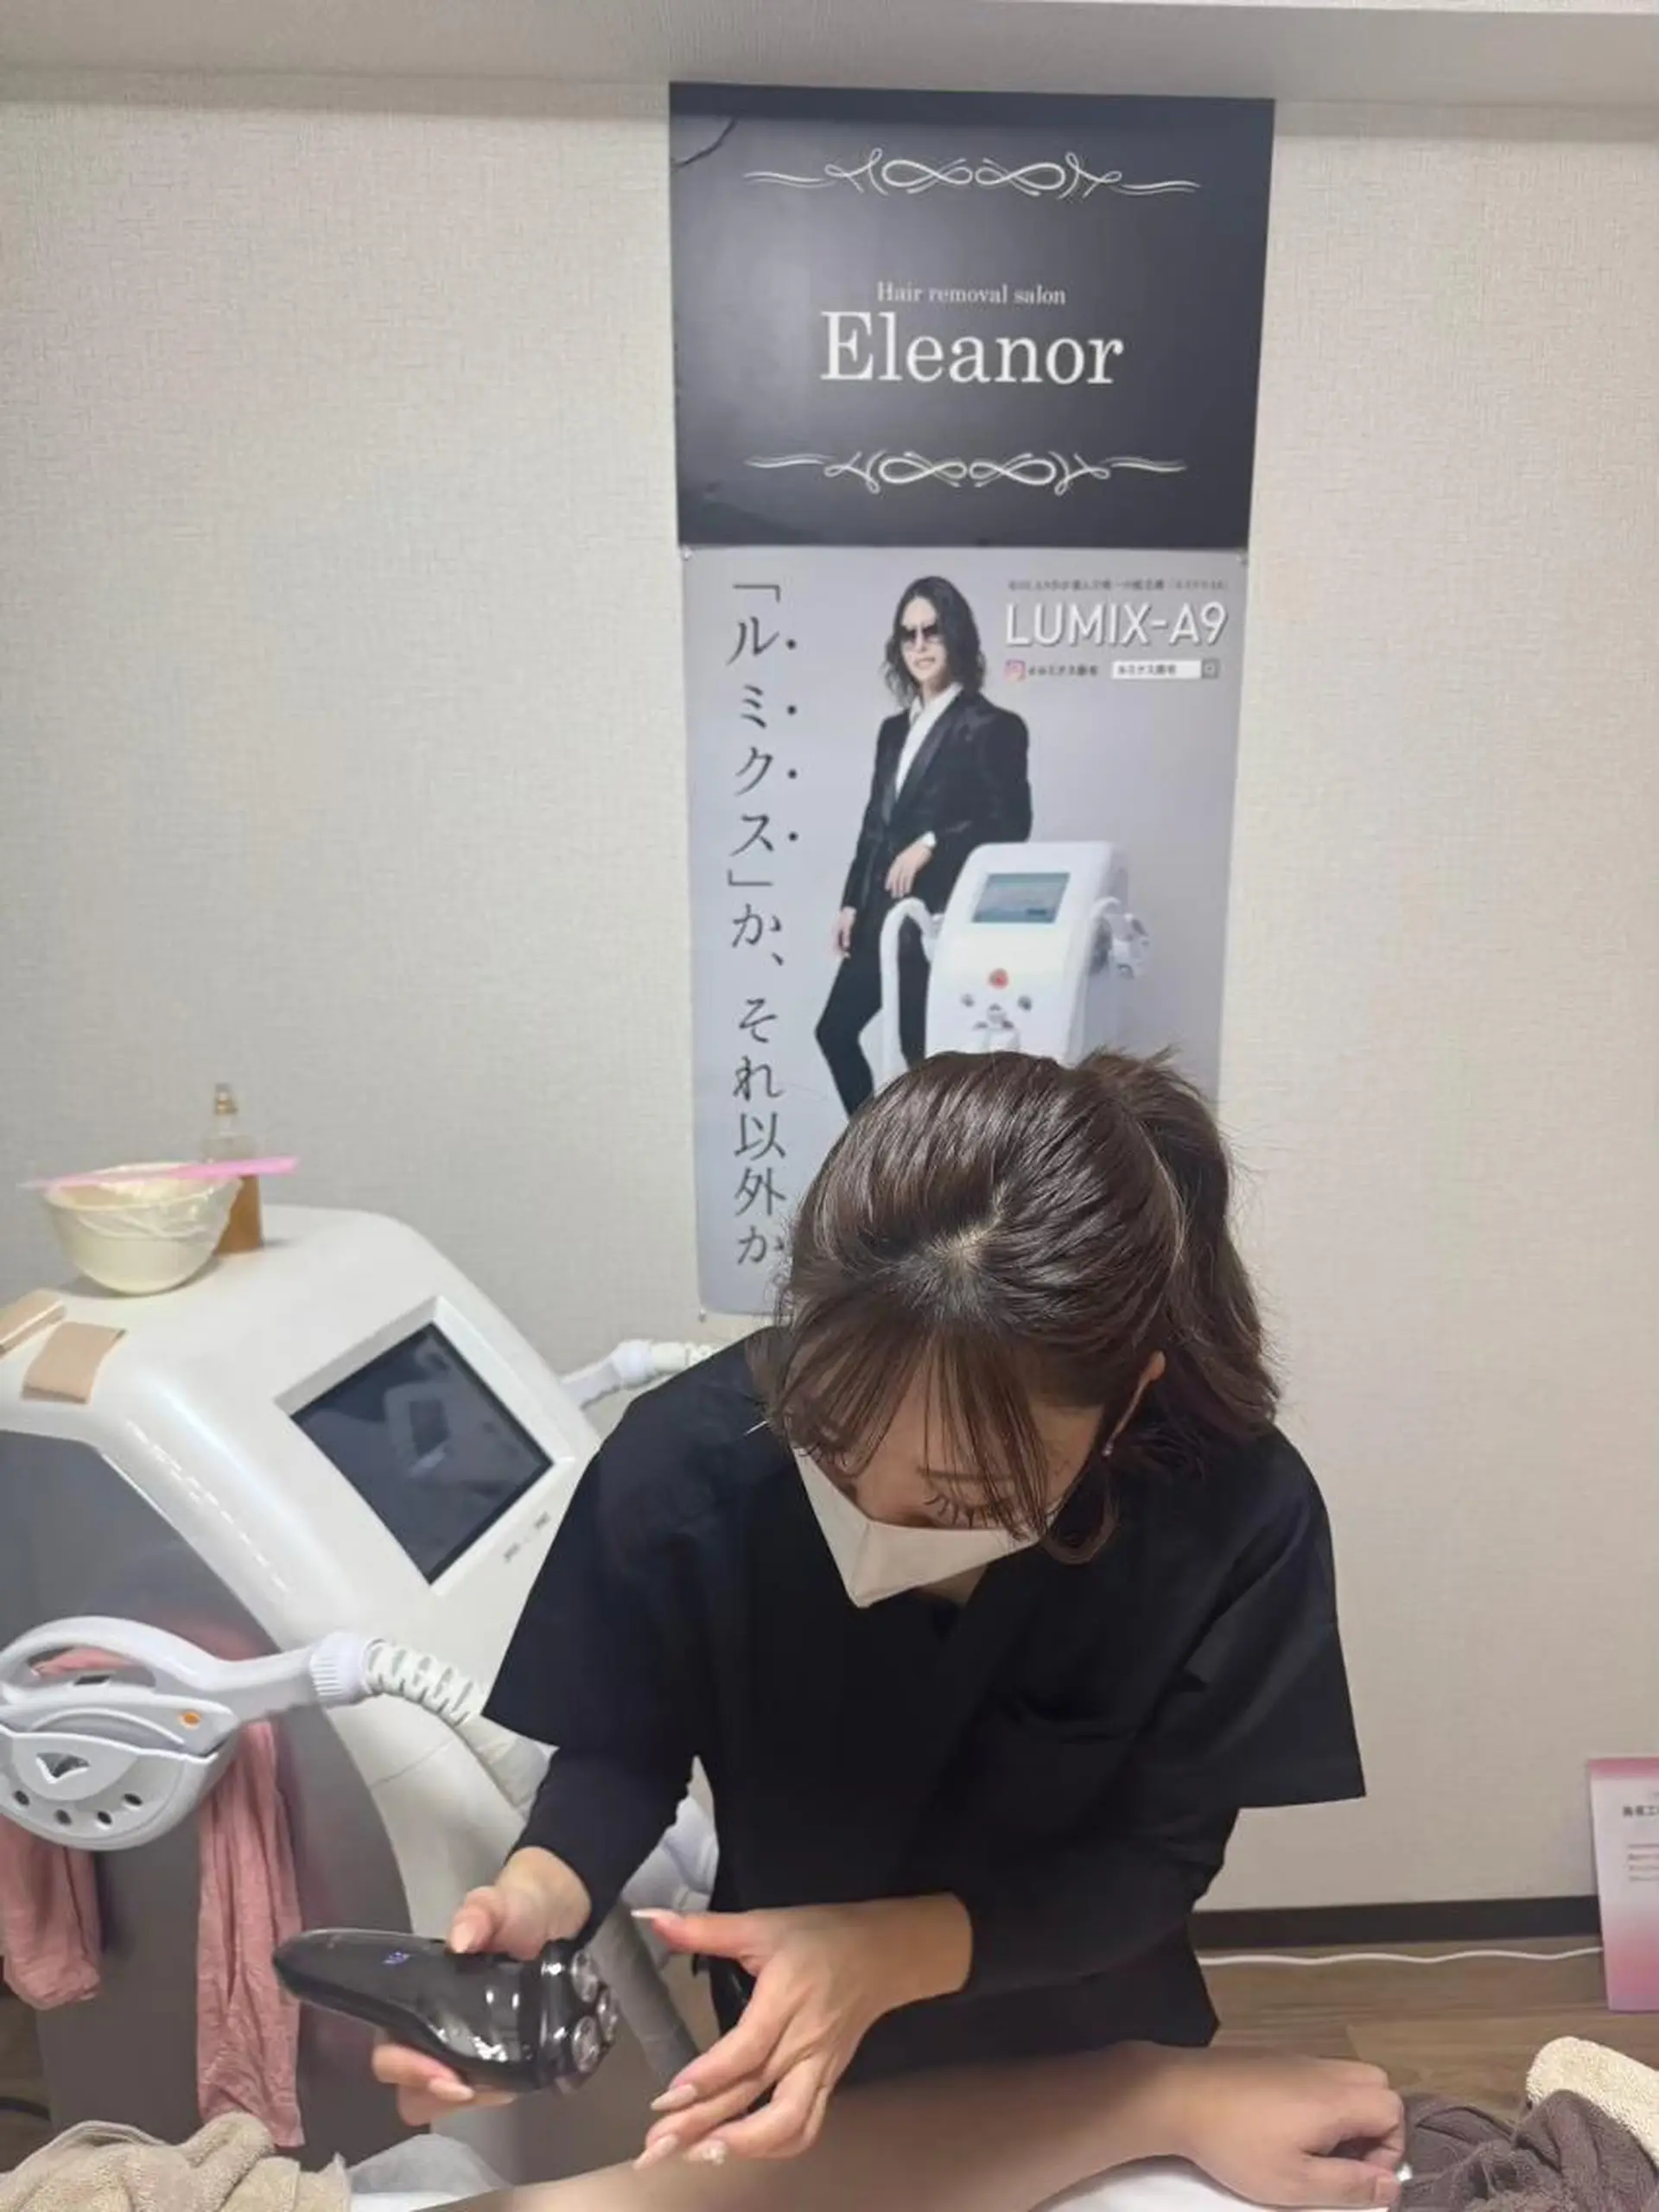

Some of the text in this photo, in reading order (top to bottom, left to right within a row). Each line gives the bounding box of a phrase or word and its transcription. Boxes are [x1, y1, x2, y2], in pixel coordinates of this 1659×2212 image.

[876, 281, 1067, 305] Hair removal salon
[820, 310, 1124, 385] Eleanor
[1006, 601, 1229, 646] LUMIX-A9
